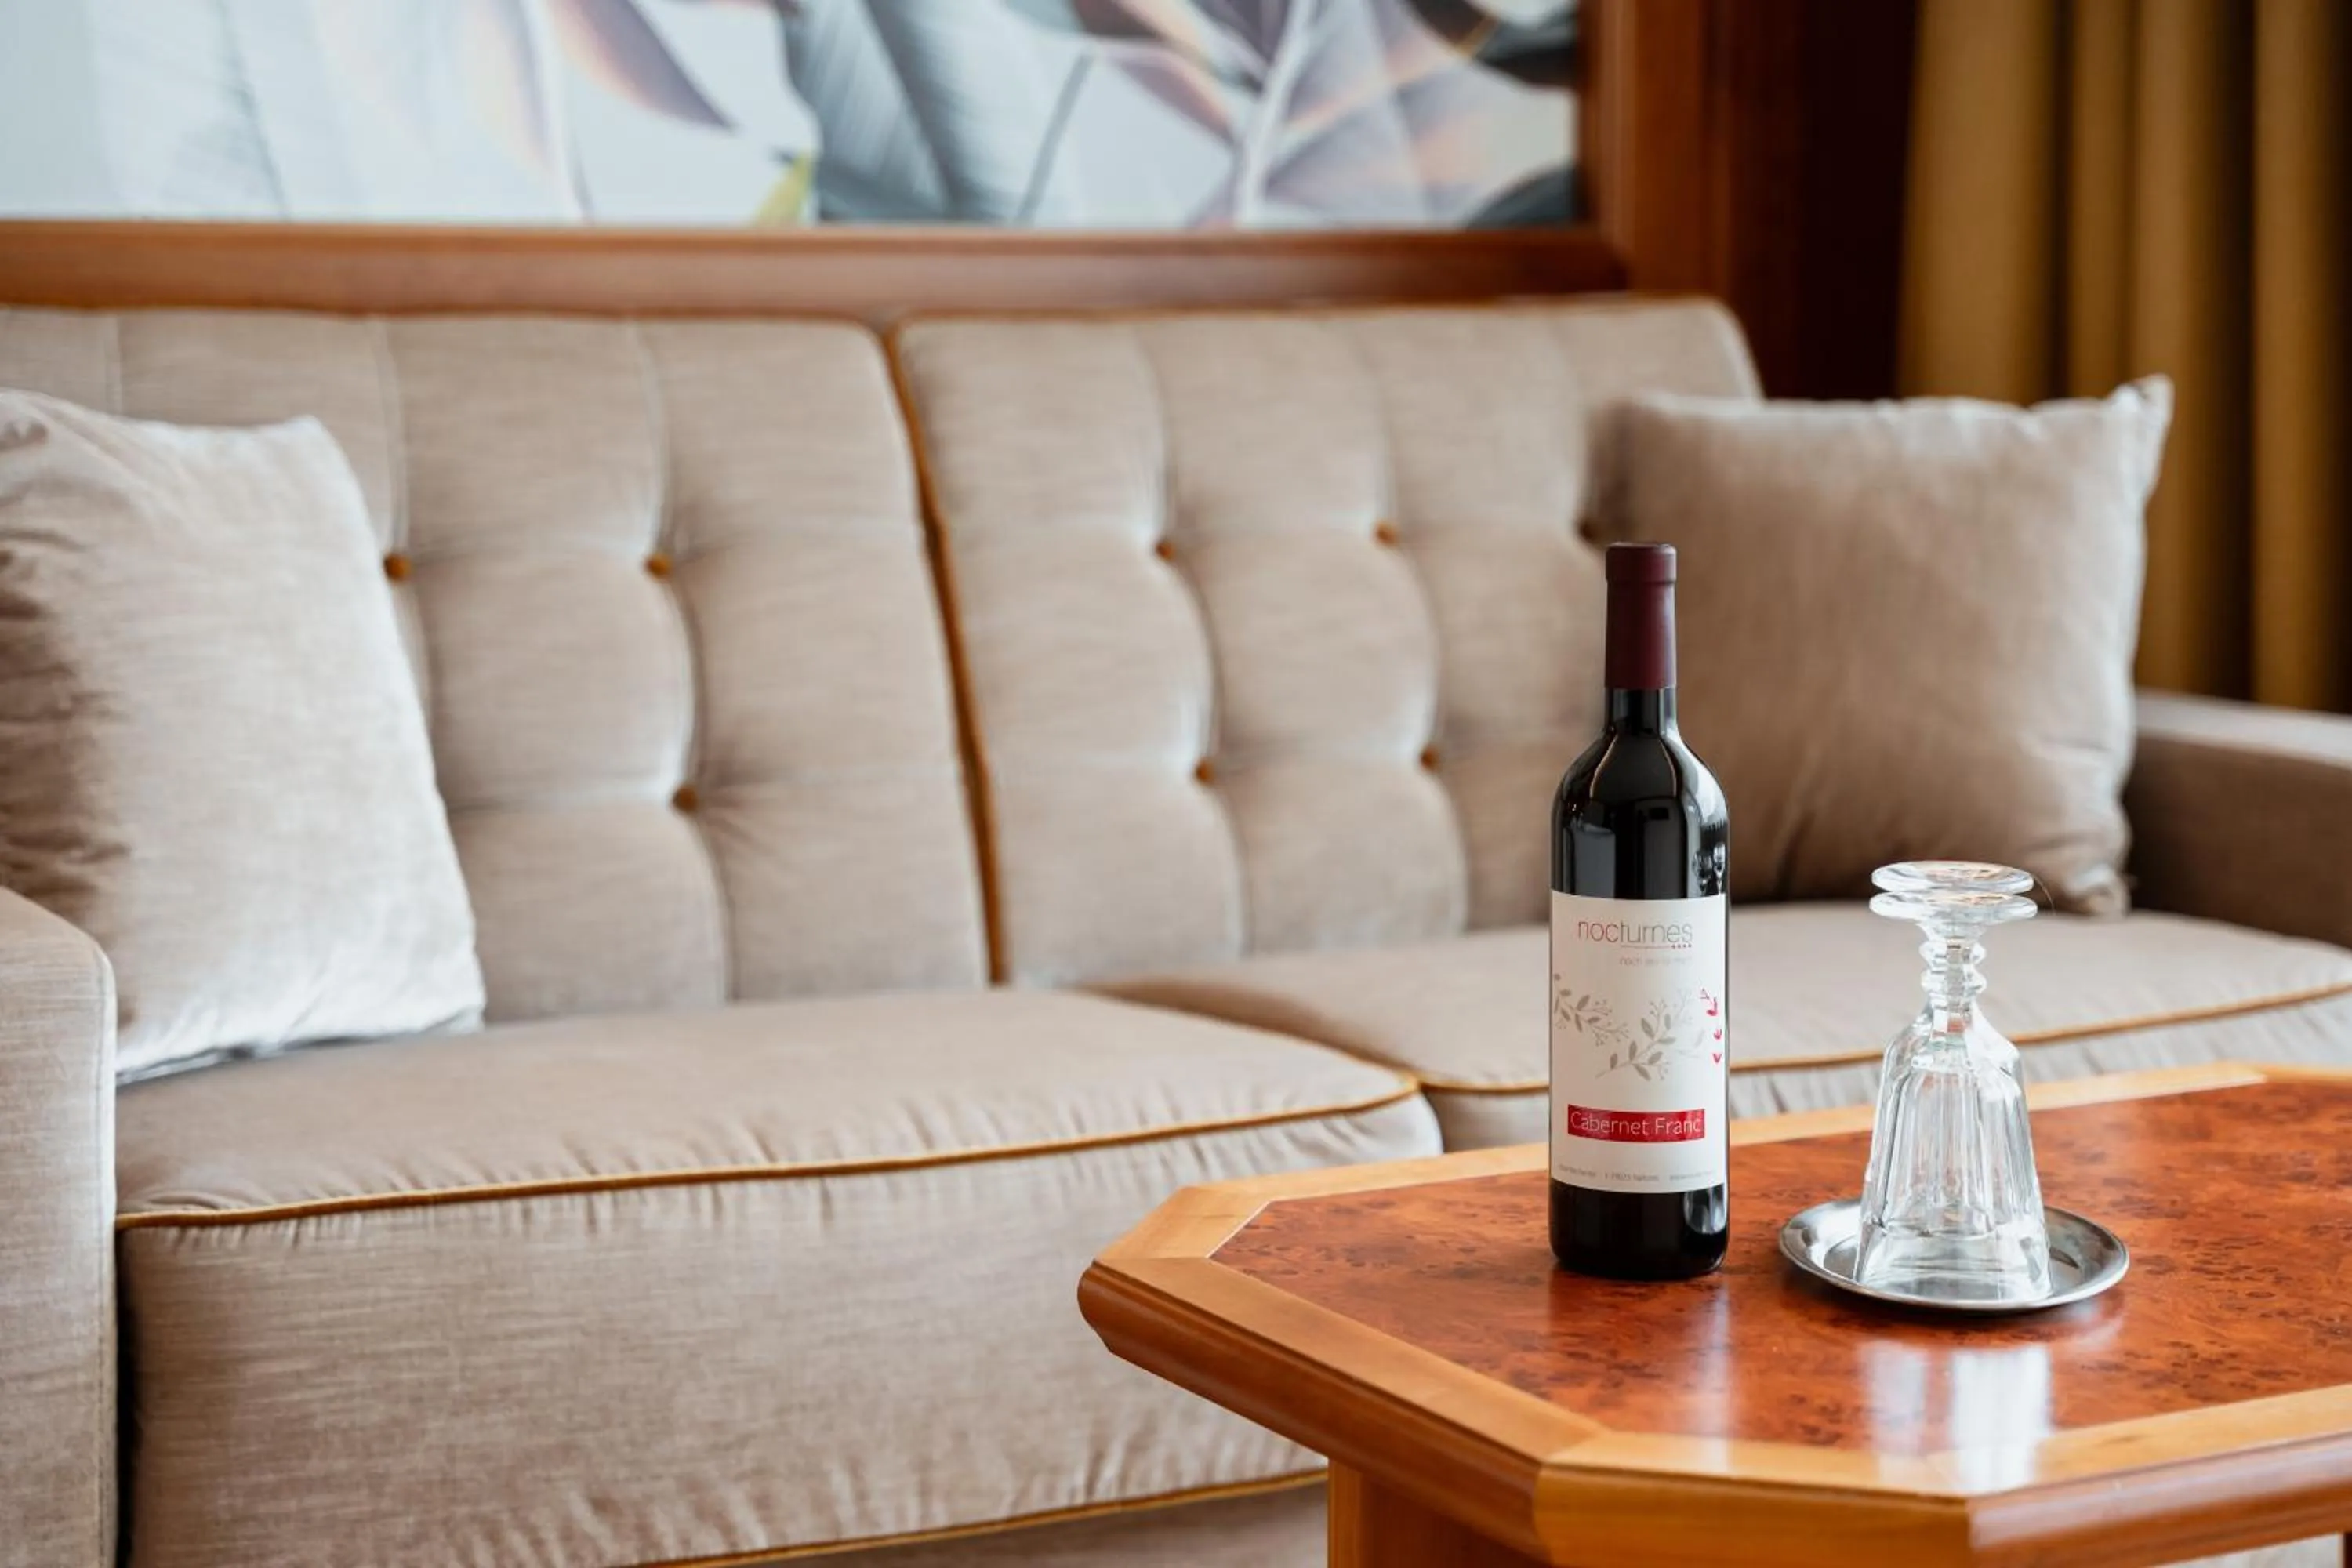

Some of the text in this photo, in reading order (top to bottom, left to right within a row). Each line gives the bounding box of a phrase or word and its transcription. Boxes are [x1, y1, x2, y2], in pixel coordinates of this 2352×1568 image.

[1577, 920, 1693, 943] nocturnes
[1570, 1111, 1702, 1135] Cabernet Franc
